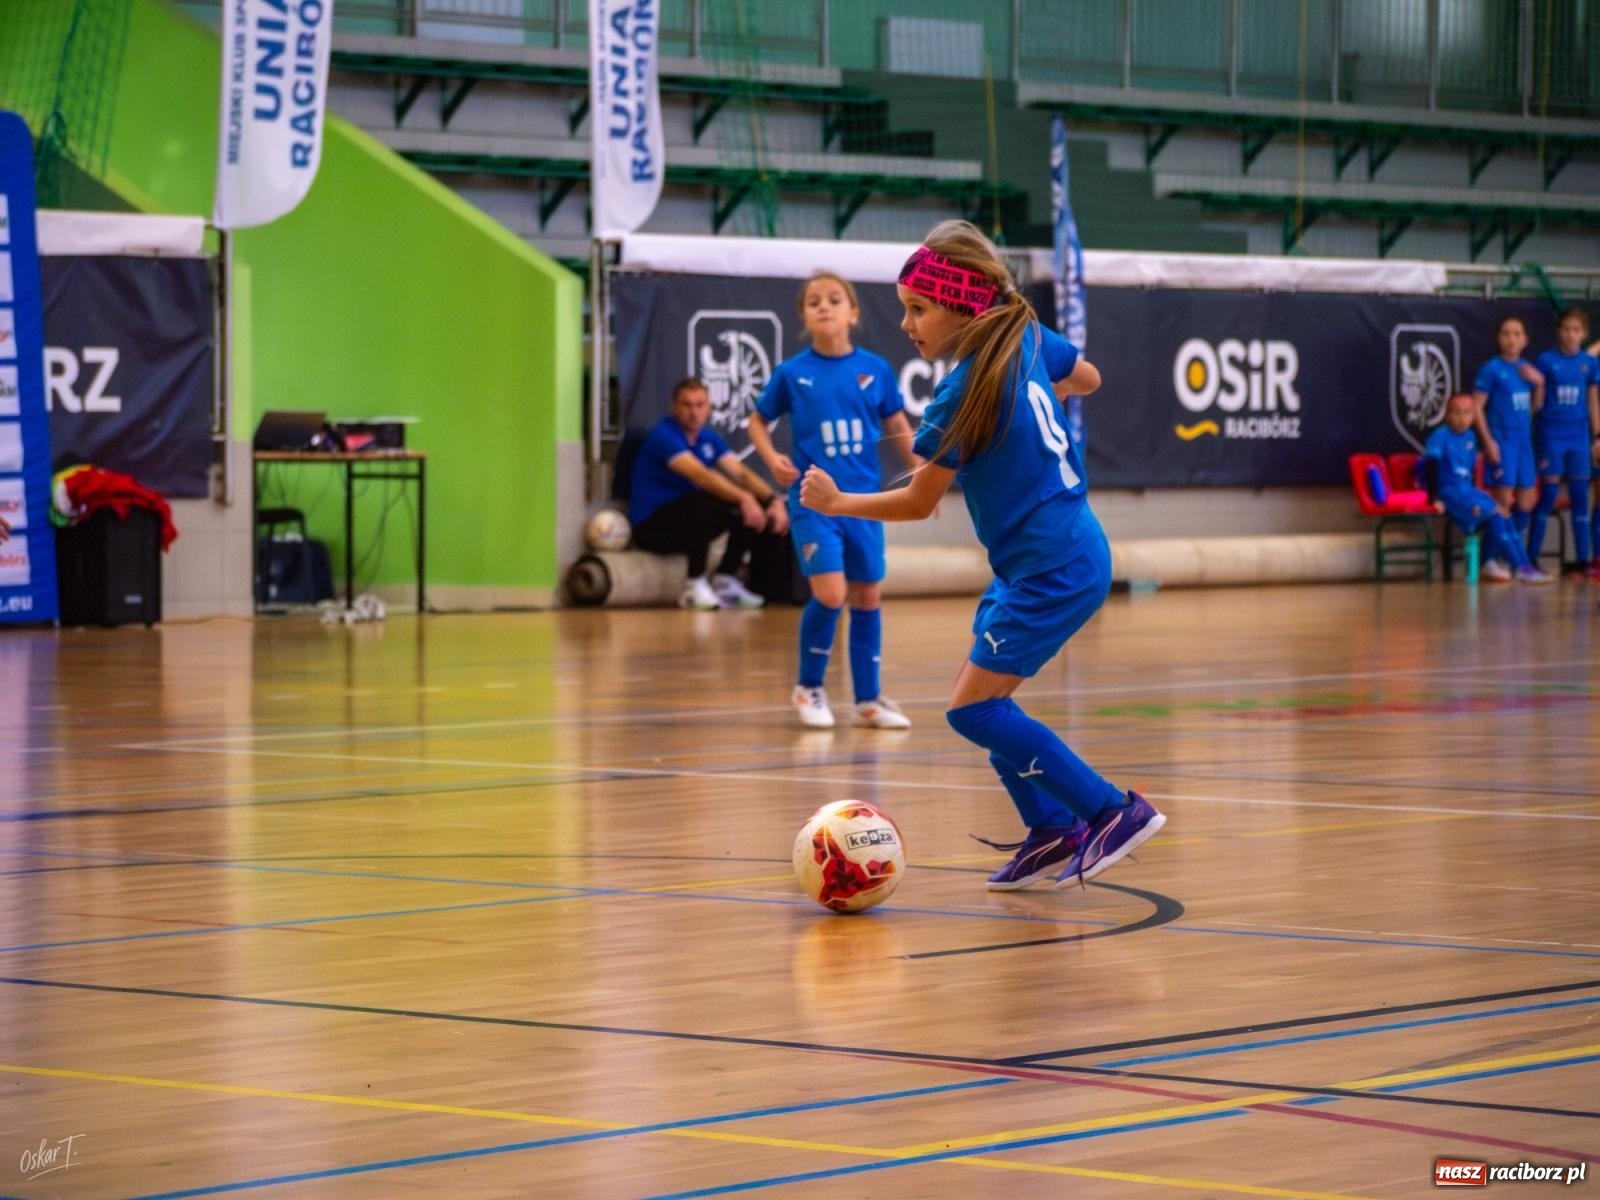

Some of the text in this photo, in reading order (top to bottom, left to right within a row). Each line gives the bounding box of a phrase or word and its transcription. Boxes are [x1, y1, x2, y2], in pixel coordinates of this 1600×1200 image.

[235, 0, 248, 27] SP
[232, 33, 246, 83] KLUB
[609, 6, 632, 139] UNIA
[941, 283, 961, 300] FCB
[43, 346, 122, 413] RZ
[1028, 380, 1081, 489] 9
